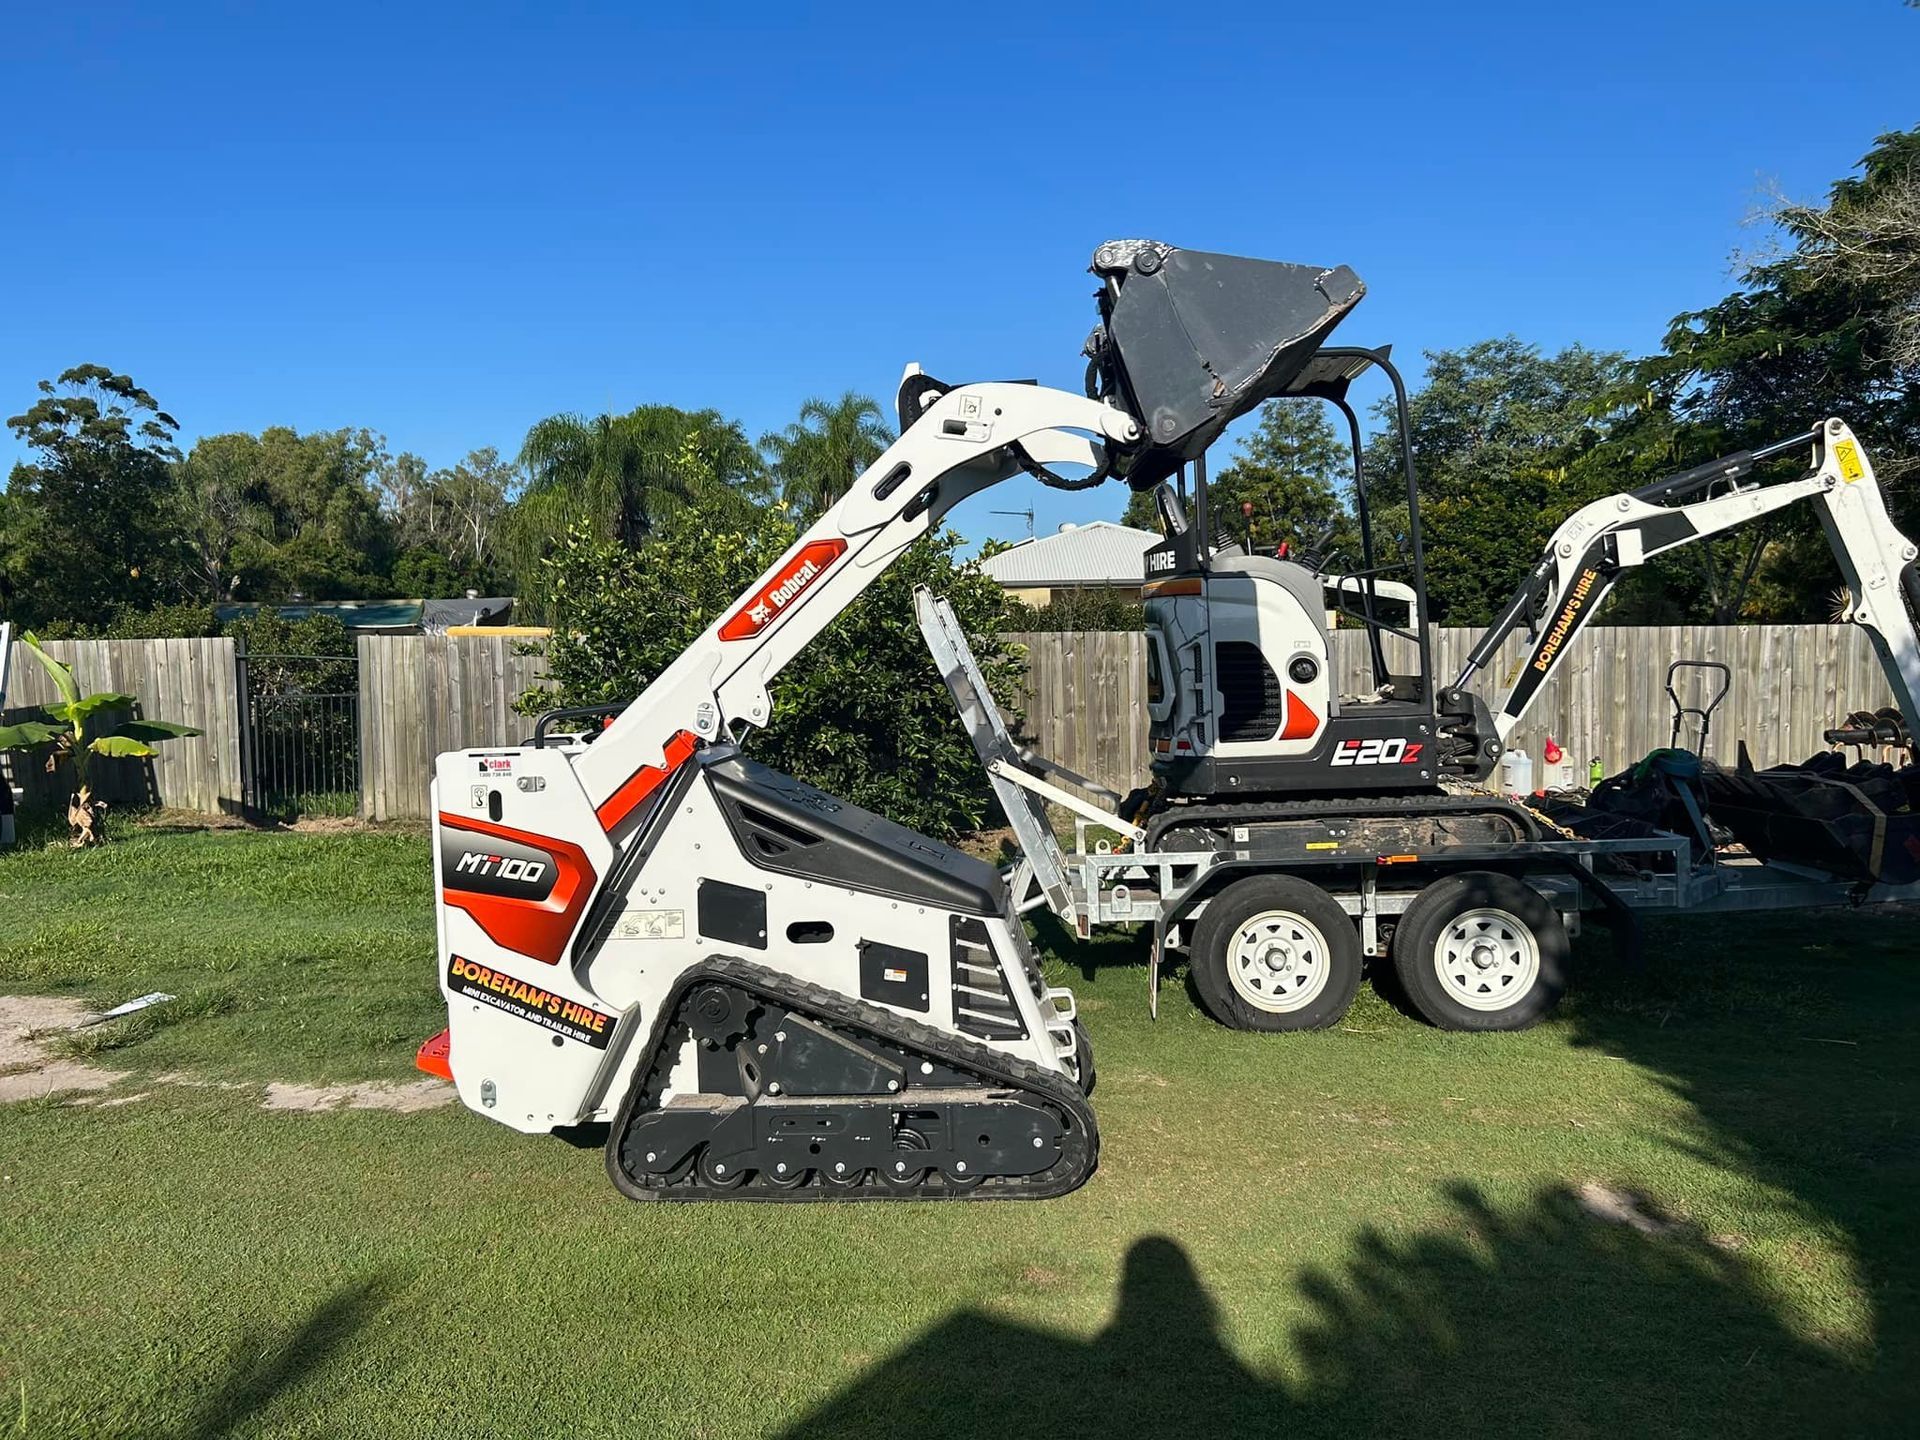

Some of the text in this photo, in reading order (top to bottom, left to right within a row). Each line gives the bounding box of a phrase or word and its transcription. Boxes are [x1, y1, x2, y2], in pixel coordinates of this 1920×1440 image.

[768, 559, 820, 608] Bobcat
[1150, 550, 1176, 572] HIRE
[1534, 598, 1582, 672] BOREHAM'S
[1573, 568, 1597, 601] HIRE
[489, 759, 511, 769] clark
[456, 851, 546, 882] MT100
[452, 956, 608, 1033] BOREHAM'S HIRE
[462, 985, 592, 1043] MINI EXCAVATOR AND TRAILER HIRE
